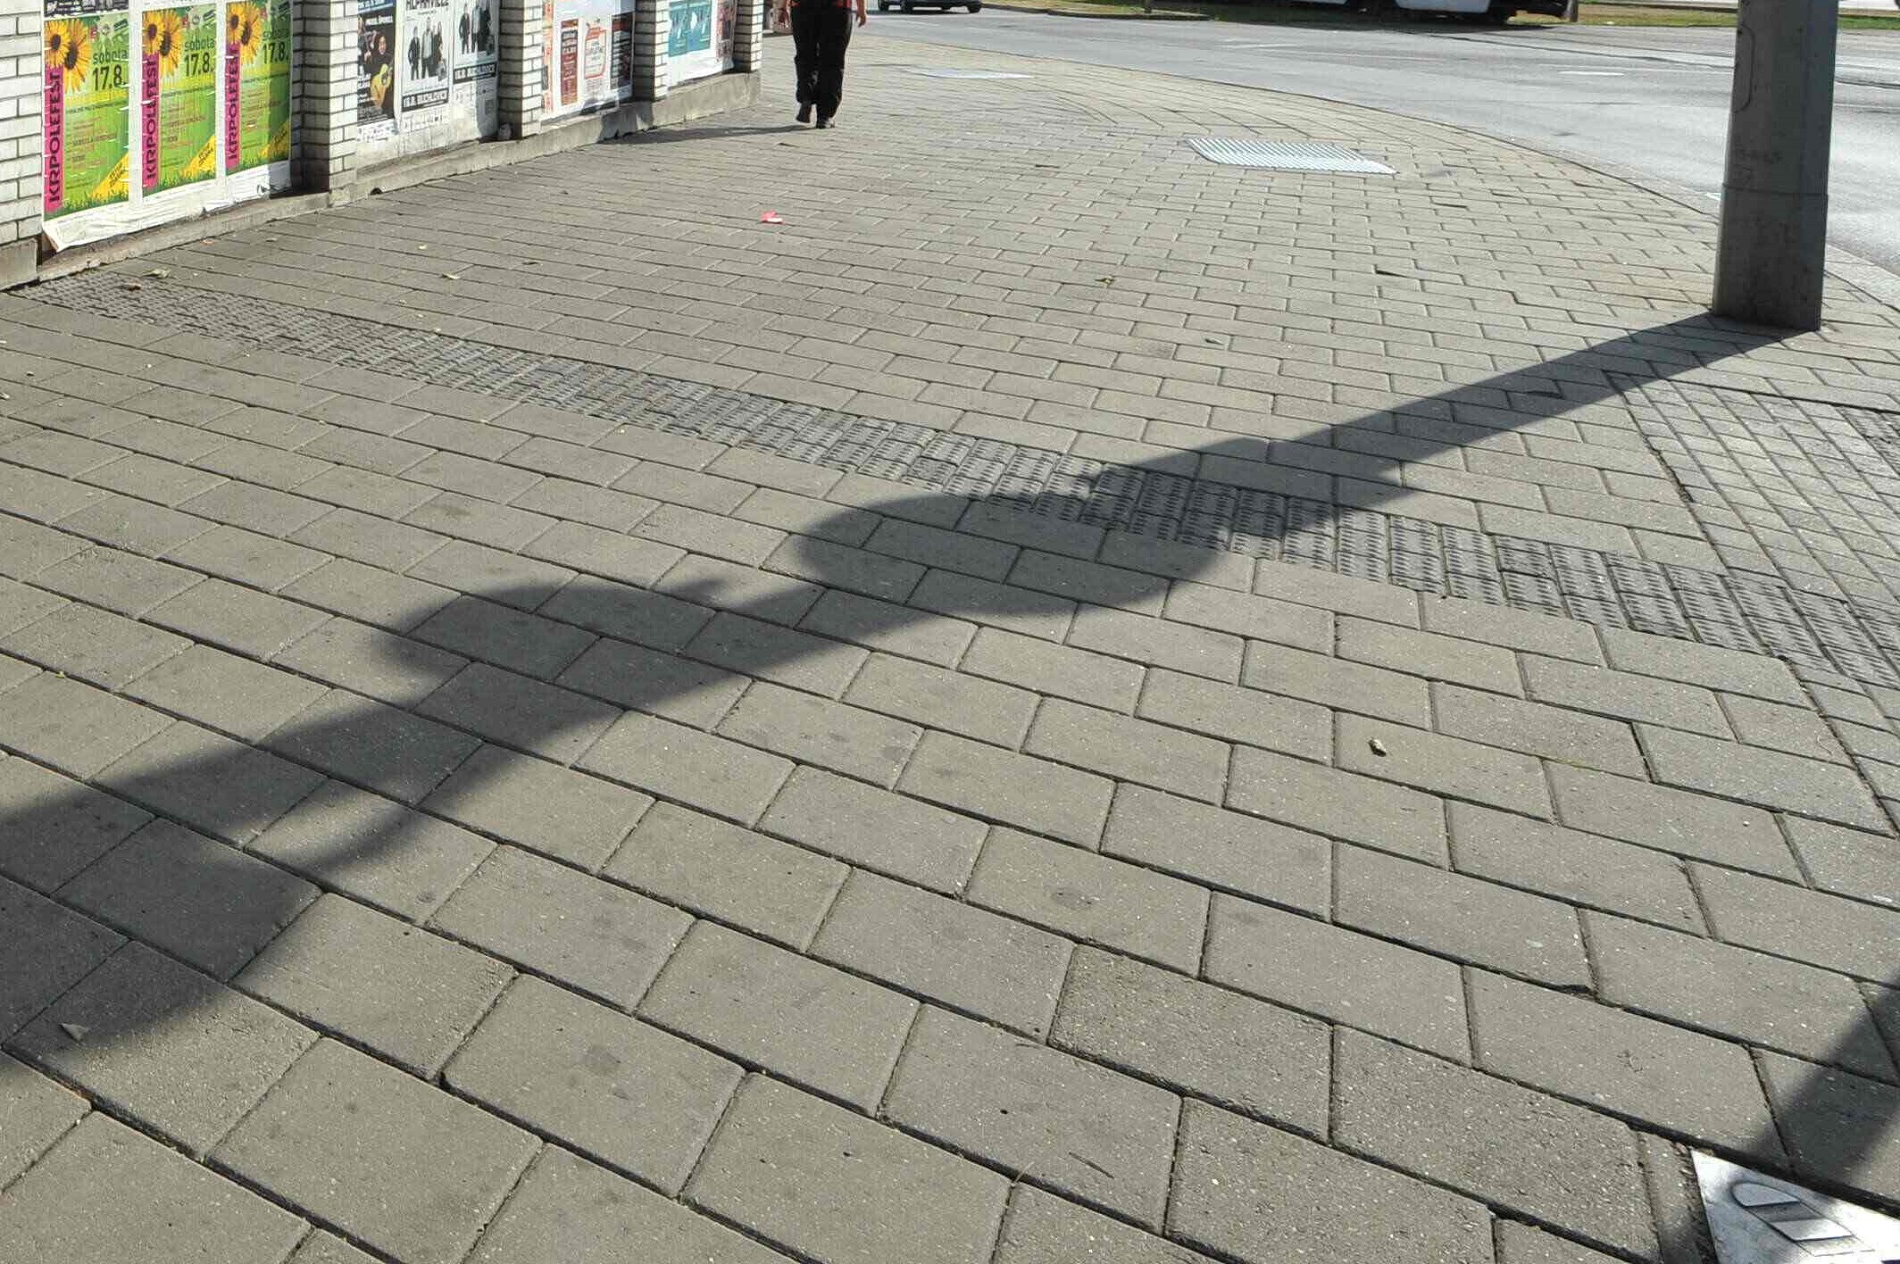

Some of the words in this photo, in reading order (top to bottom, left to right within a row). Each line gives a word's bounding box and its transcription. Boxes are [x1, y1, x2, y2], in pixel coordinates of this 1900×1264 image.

[184, 35, 215, 51] sobota
[93, 49, 127, 65] sobota
[184, 52, 214, 77] 17.8.
[49, 72, 61, 202] KRPOLEFEST
